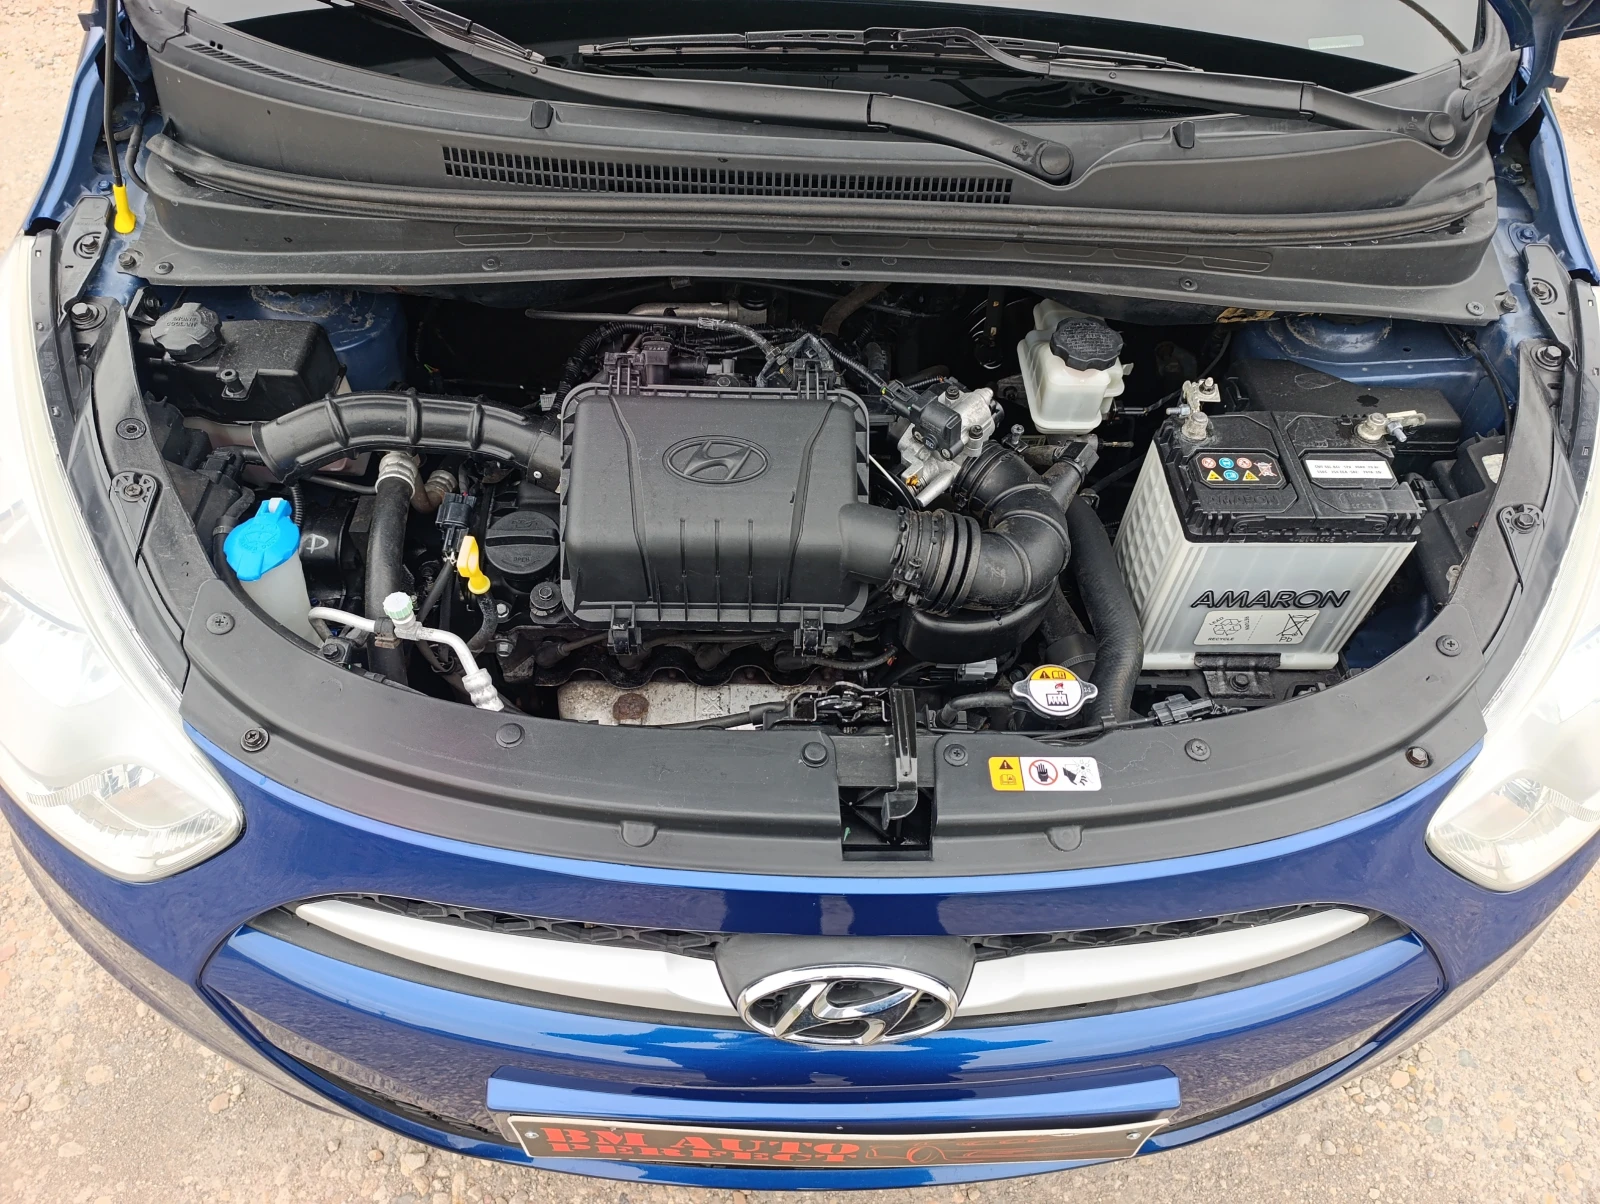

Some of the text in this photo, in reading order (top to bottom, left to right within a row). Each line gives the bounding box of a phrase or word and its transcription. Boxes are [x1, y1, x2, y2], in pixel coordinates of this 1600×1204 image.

[1191, 589, 1351, 609] AMARON
[1209, 616, 1224, 626] LEAD
[540, 1127, 860, 1155] BM AUTO
[549, 1143, 857, 1162] PERFECT
